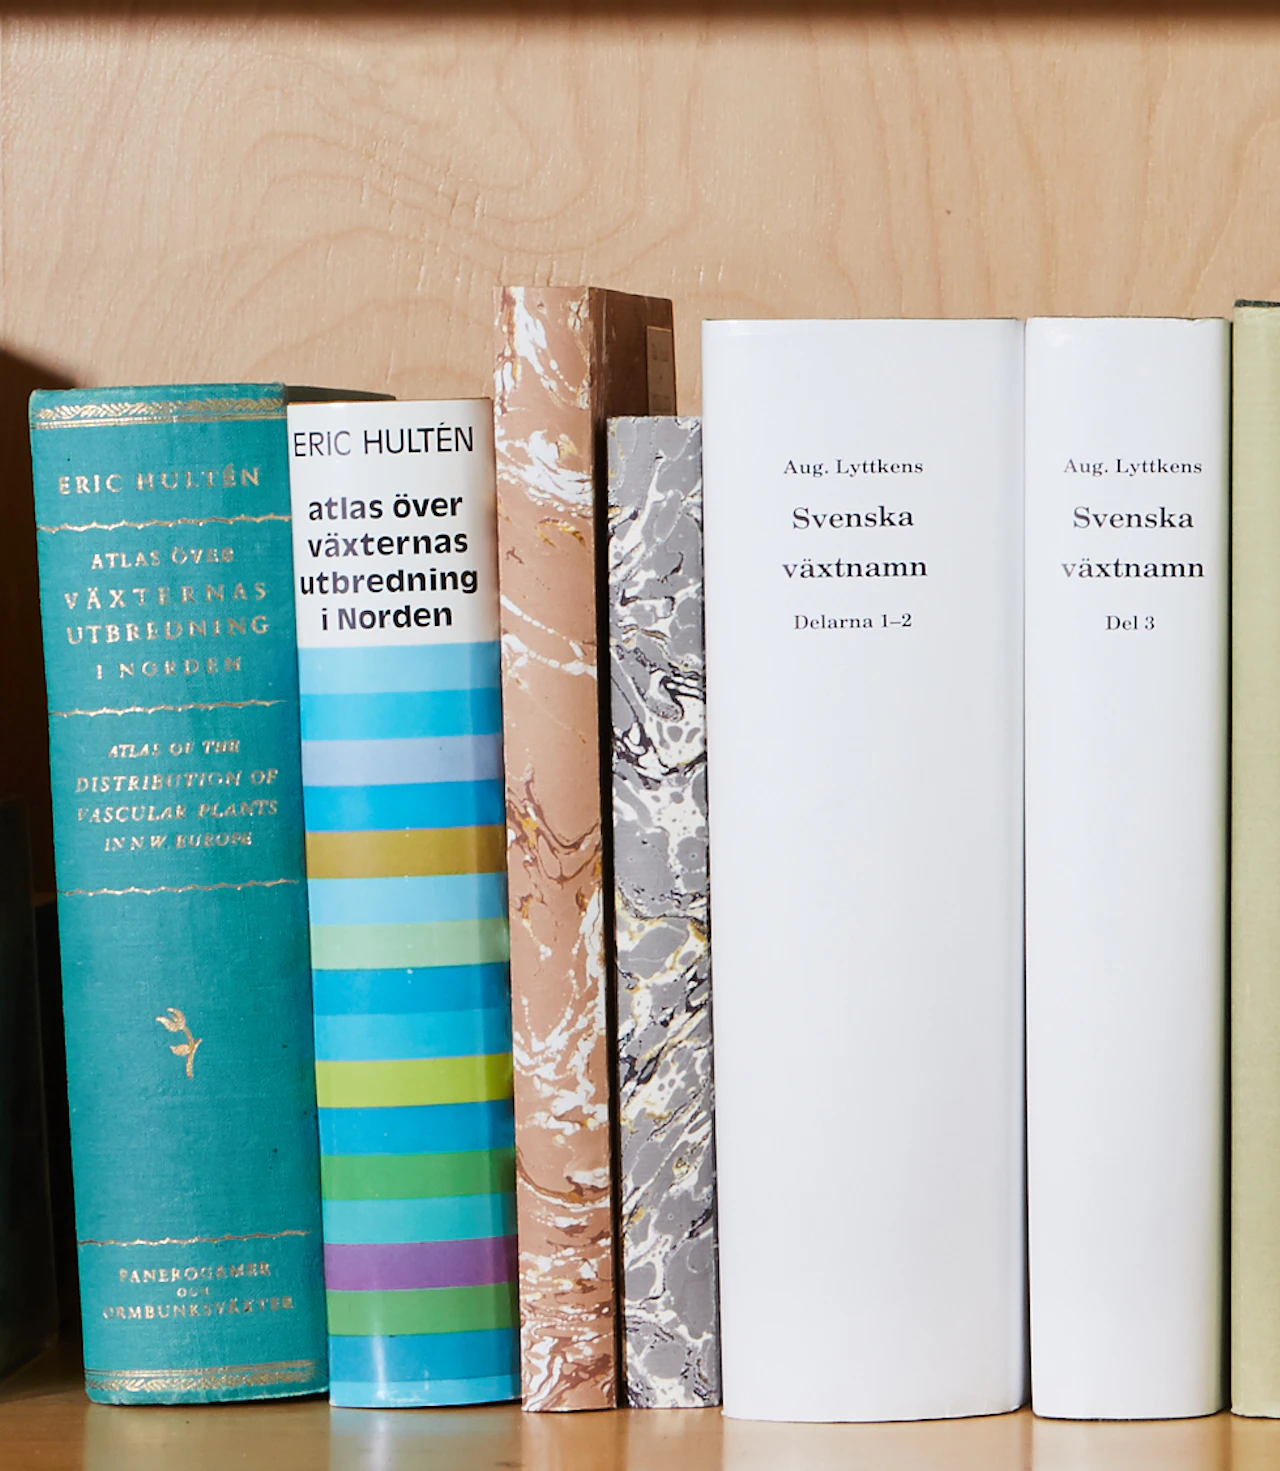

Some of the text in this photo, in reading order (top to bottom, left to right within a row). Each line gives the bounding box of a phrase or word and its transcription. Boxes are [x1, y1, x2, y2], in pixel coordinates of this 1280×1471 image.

[294, 422, 474, 457] ERIC HULTÉN
[58, 464, 260, 495] ERIC HULTÉN
[783, 459, 924, 478] Aug. Lyttkens
[1064, 458, 1203, 478] Aug. Lyttkens
[308, 493, 463, 521] atlas över
[792, 506, 915, 531] Svenska
[1072, 505, 1195, 530] Svenska
[308, 532, 469, 558] växternas
[91, 546, 234, 570] ATLAS ÖVER
[782, 558, 929, 580] växtnamn
[1061, 558, 1206, 580] växtnamn
[300, 568, 479, 596] utbredning
[64, 582, 267, 610] VÄXTERNAS
[66, 615, 269, 645] UTBREDNING
[321, 605, 453, 631] i Norden
[794, 614, 874, 631] Delarna
[1105, 615, 1156, 631] Del 3
[96, 656, 242, 680] I NORDEN
[107, 743, 160, 759] ATLAS
[201, 739, 241, 754] THE
[75, 768, 279, 793] DISTRIBUTION OF
[77, 800, 278, 824] VASCULAR PLANTS
[174, 831, 253, 849] EUROPE
[119, 1261, 271, 1284] FANEROGAMER
[102, 1296, 294, 1320] ORMBUNKSVÄXTER
